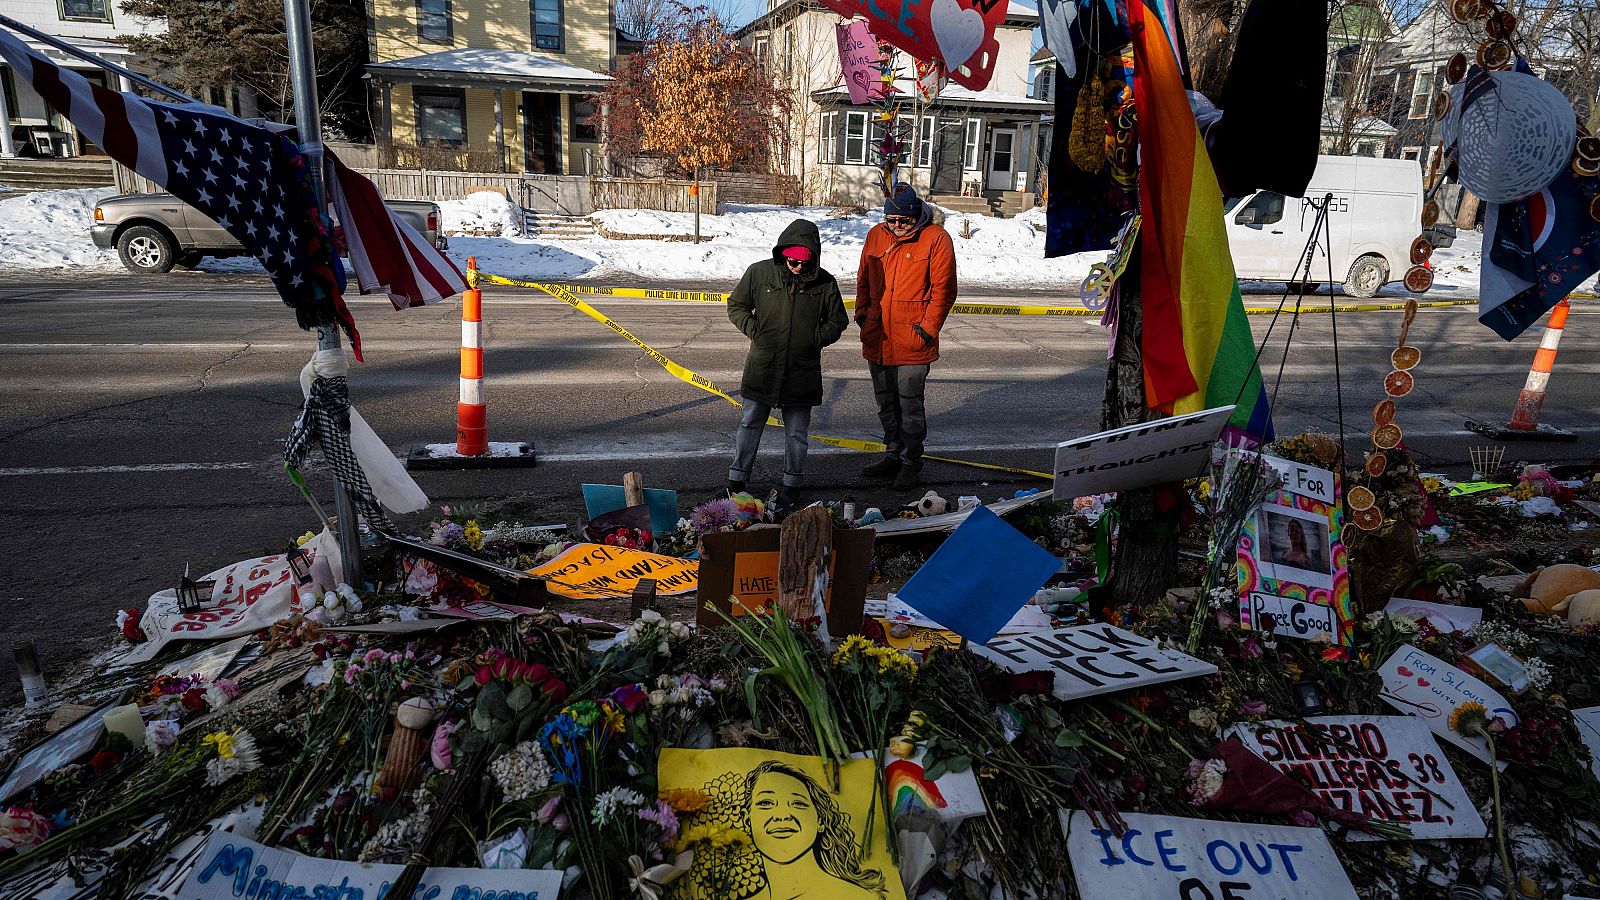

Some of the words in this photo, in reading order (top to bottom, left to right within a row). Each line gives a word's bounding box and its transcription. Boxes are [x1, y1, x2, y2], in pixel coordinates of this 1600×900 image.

[848, 54, 870, 67] Wins
[547, 284, 561, 296] LINE
[579, 285, 592, 293] NOT
[593, 286, 614, 295] CROSS
[644, 289, 665, 298] POLICE
[666, 291, 679, 299] LINE
[680, 292, 688, 300] DO
[689, 292, 701, 301] NOT
[703, 293, 722, 302] CROSS
[560, 291, 580, 307] POLICE
[952, 305, 971, 314] POLICE
[971, 306, 983, 314] LINE
[604, 319, 623, 333] CROSS
[653, 351, 669, 367] POLICE
[691, 373, 709, 388] CROSS
[1058, 440, 1213, 478] THOUGHTS
[739, 576, 776, 592] HATE
[1254, 595, 1290, 630] Rnee
[1291, 603, 1333, 634] Good
[985, 627, 1149, 664] FUCK
[1050, 650, 1183, 687] ICE
[1404, 651, 1437, 675] FROM
[1431, 686, 1456, 705] WITH
[1255, 722, 1389, 761] SILVERIO
[1408, 753, 1446, 785] 38
[1090, 829, 1187, 872] ICE
[1206, 839, 1303, 881] OUT
